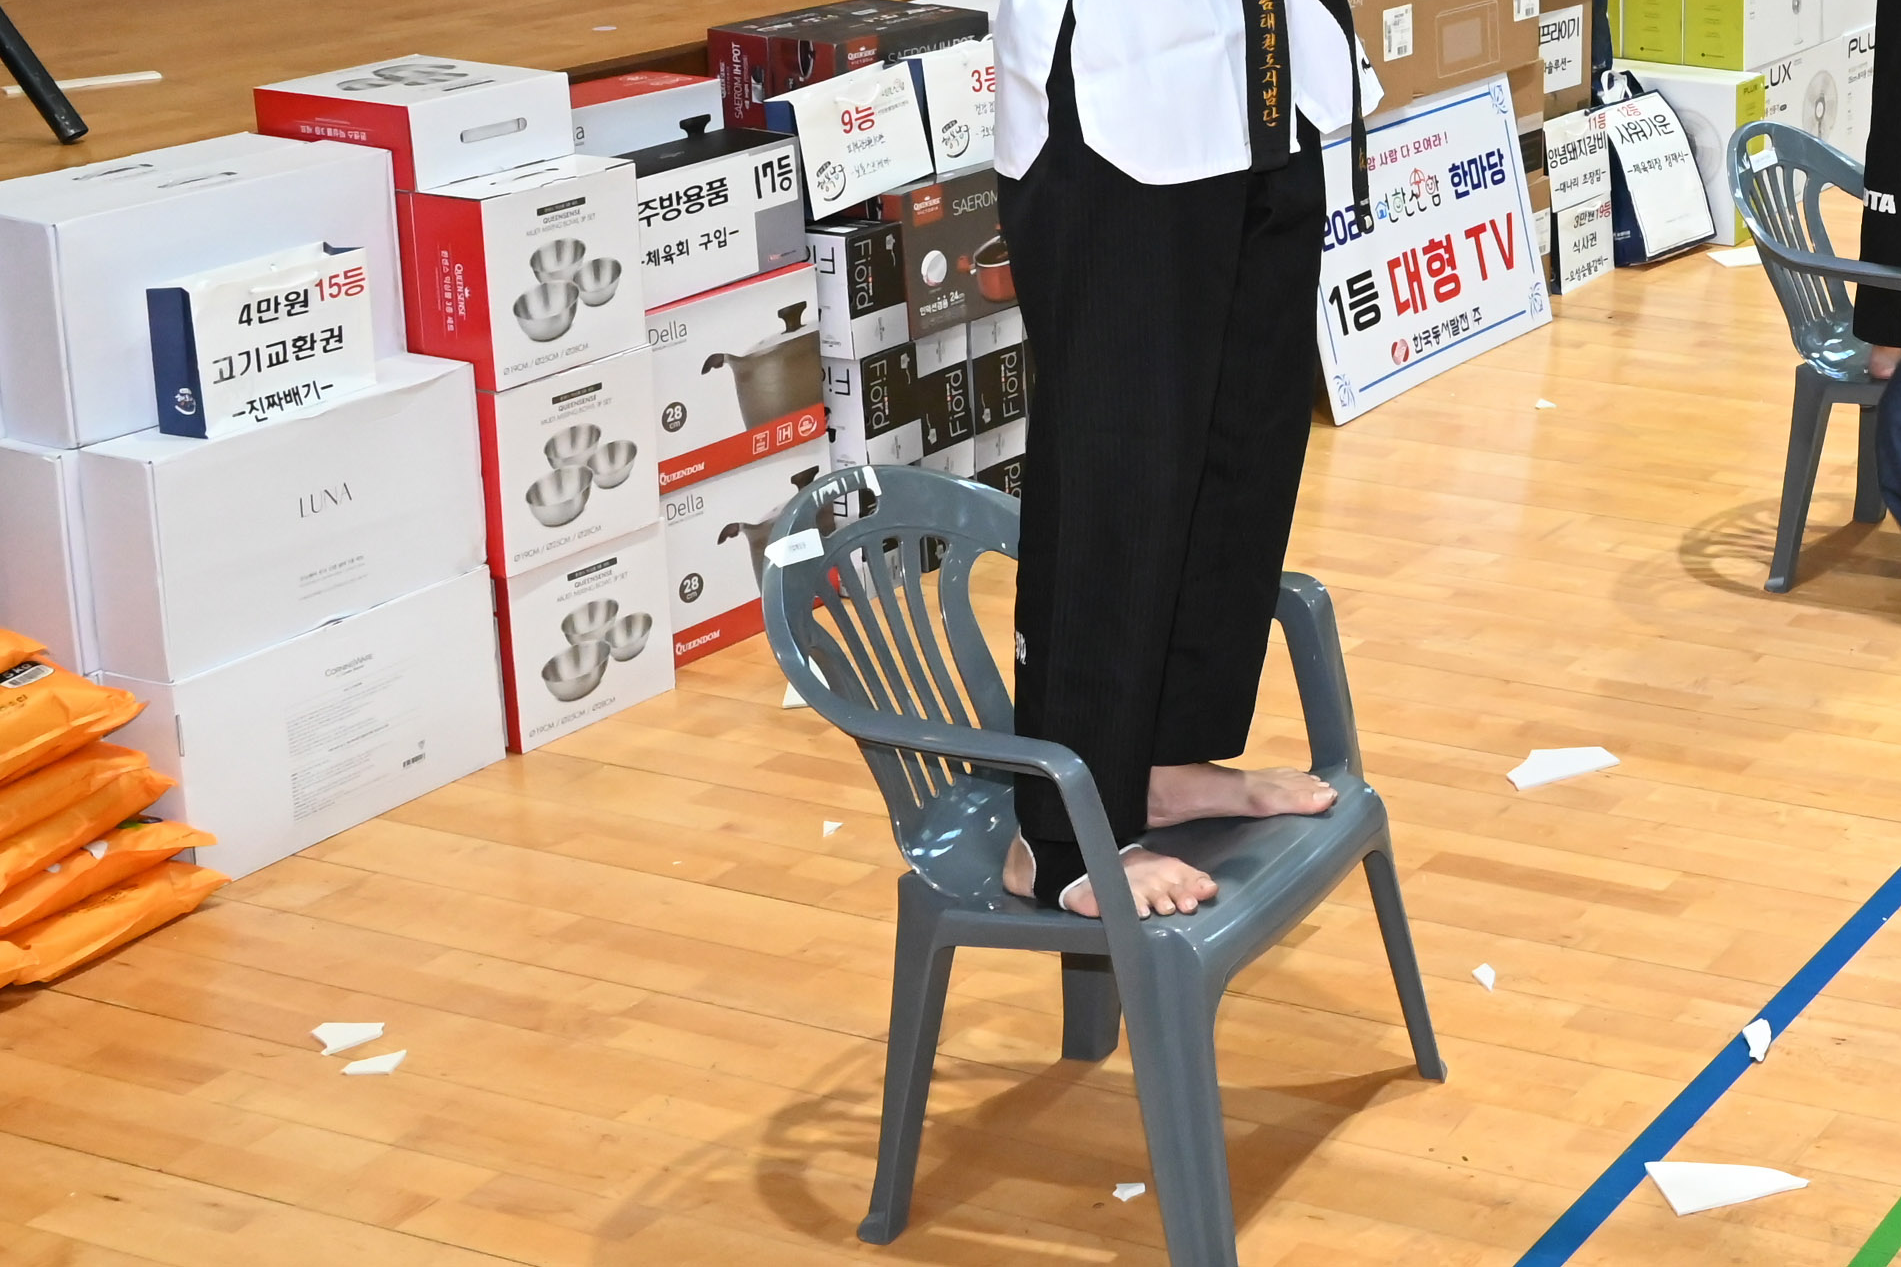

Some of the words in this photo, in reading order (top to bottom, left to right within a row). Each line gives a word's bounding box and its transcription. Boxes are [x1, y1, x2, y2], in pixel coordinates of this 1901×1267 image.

[731, 42, 741, 60] POT
[734, 76, 746, 119] SAEROM
[1617, 103, 1642, 118] 12등
[1588, 112, 1607, 131] 11등
[1379, 149, 1398, 167] 사람
[1400, 144, 1411, 159] 다
[1413, 134, 1443, 155] 모여라
[1547, 131, 1608, 170] 양념돼지갈비
[754, 154, 793, 199] 17등
[1448, 148, 1506, 200] 한마당
[543, 209, 581, 224] QUEENSENSE
[637, 177, 729, 227] 주방용품
[1595, 201, 1612, 220] 19등
[1572, 231, 1598, 254] 식사권
[854, 239, 873, 310] Fiord
[1328, 269, 1382, 336] 1등
[1386, 233, 1463, 317] 대형
[1464, 212, 1515, 281] TV
[238, 288, 310, 326] 4만원
[315, 266, 366, 302] 15등
[648, 320, 688, 346] Della
[1412, 313, 1470, 355] 한국동서발전
[212, 325, 344, 384] 고기교환권
[232, 380, 334, 422] -진짜배기-
[870, 360, 890, 430] Fiord
[1000, 351, 1020, 418] Fiord
[558, 395, 597, 412] QUEENSENSE
[666, 405, 683, 423] 28
[945, 368, 968, 438] Fiord
[669, 420, 681, 429] cm
[778, 425, 791, 443] IH
[659, 462, 705, 486] QUEENDOM
[299, 482, 353, 519] LUNA
[666, 494, 704, 521] Della
[683, 575, 699, 594] 28
[675, 629, 721, 656] QUEENDOM
